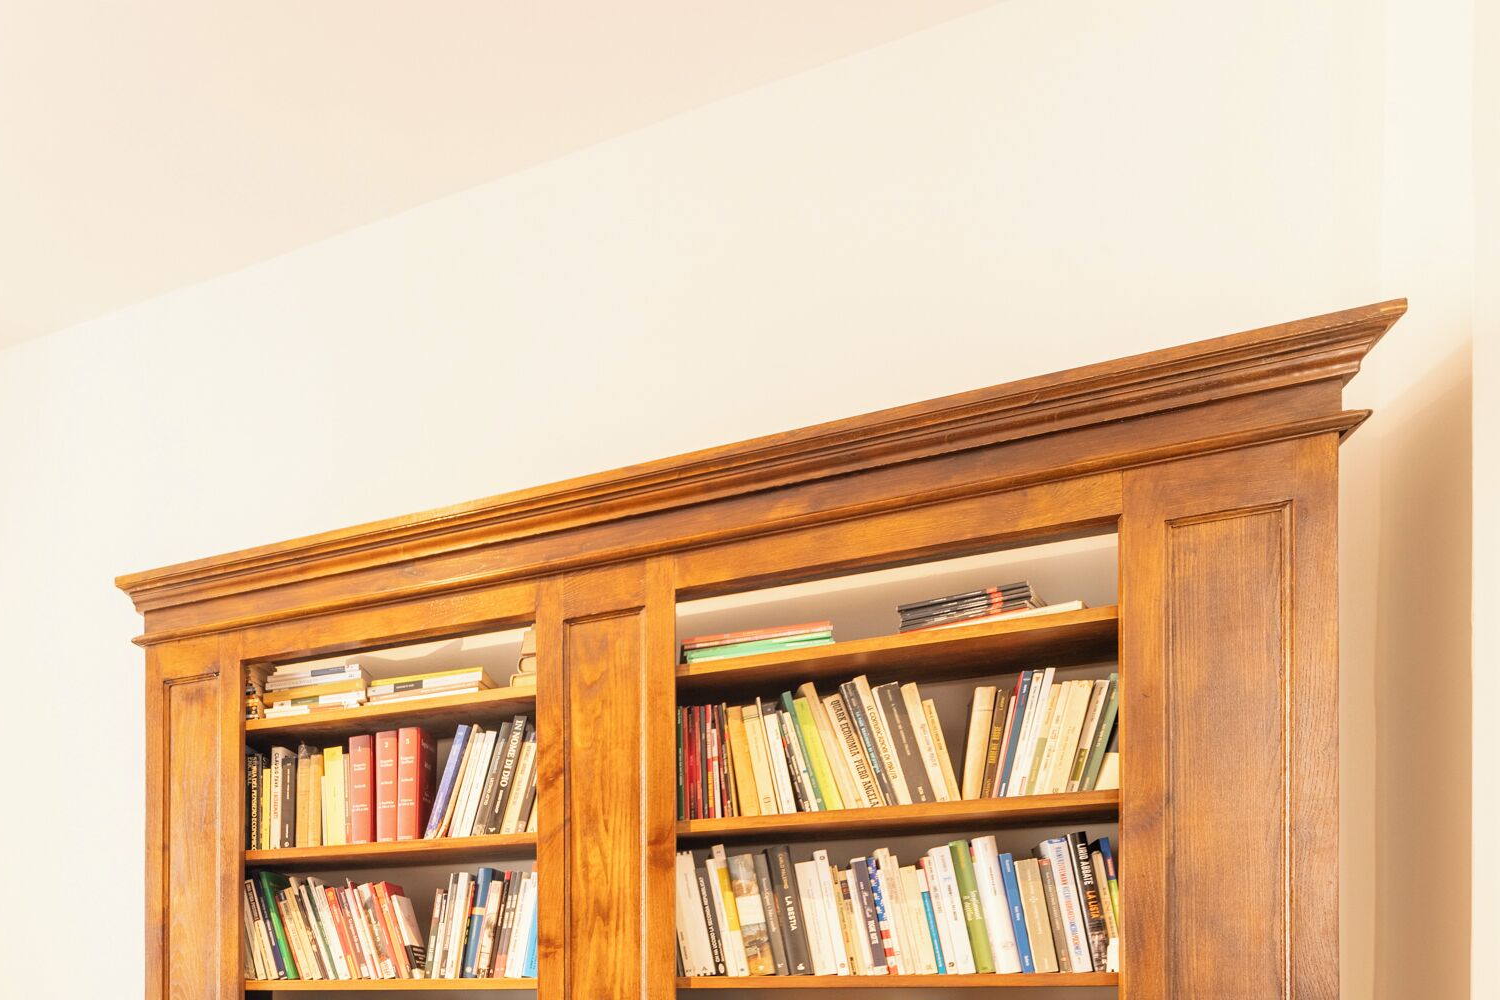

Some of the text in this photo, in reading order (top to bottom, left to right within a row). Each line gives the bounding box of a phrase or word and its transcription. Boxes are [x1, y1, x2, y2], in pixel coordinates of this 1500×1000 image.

[499, 719, 523, 787] IN NOME DI DIO
[830, 698, 846, 722] QUARK
[838, 721, 860, 757] ECONOMIA
[853, 758, 869, 780] PIERO
[861, 779, 880, 807] ANGELA
[783, 895, 800, 930] LA BESTIA
[1076, 842, 1100, 918] LIRIO ABBATE LA LISTA
